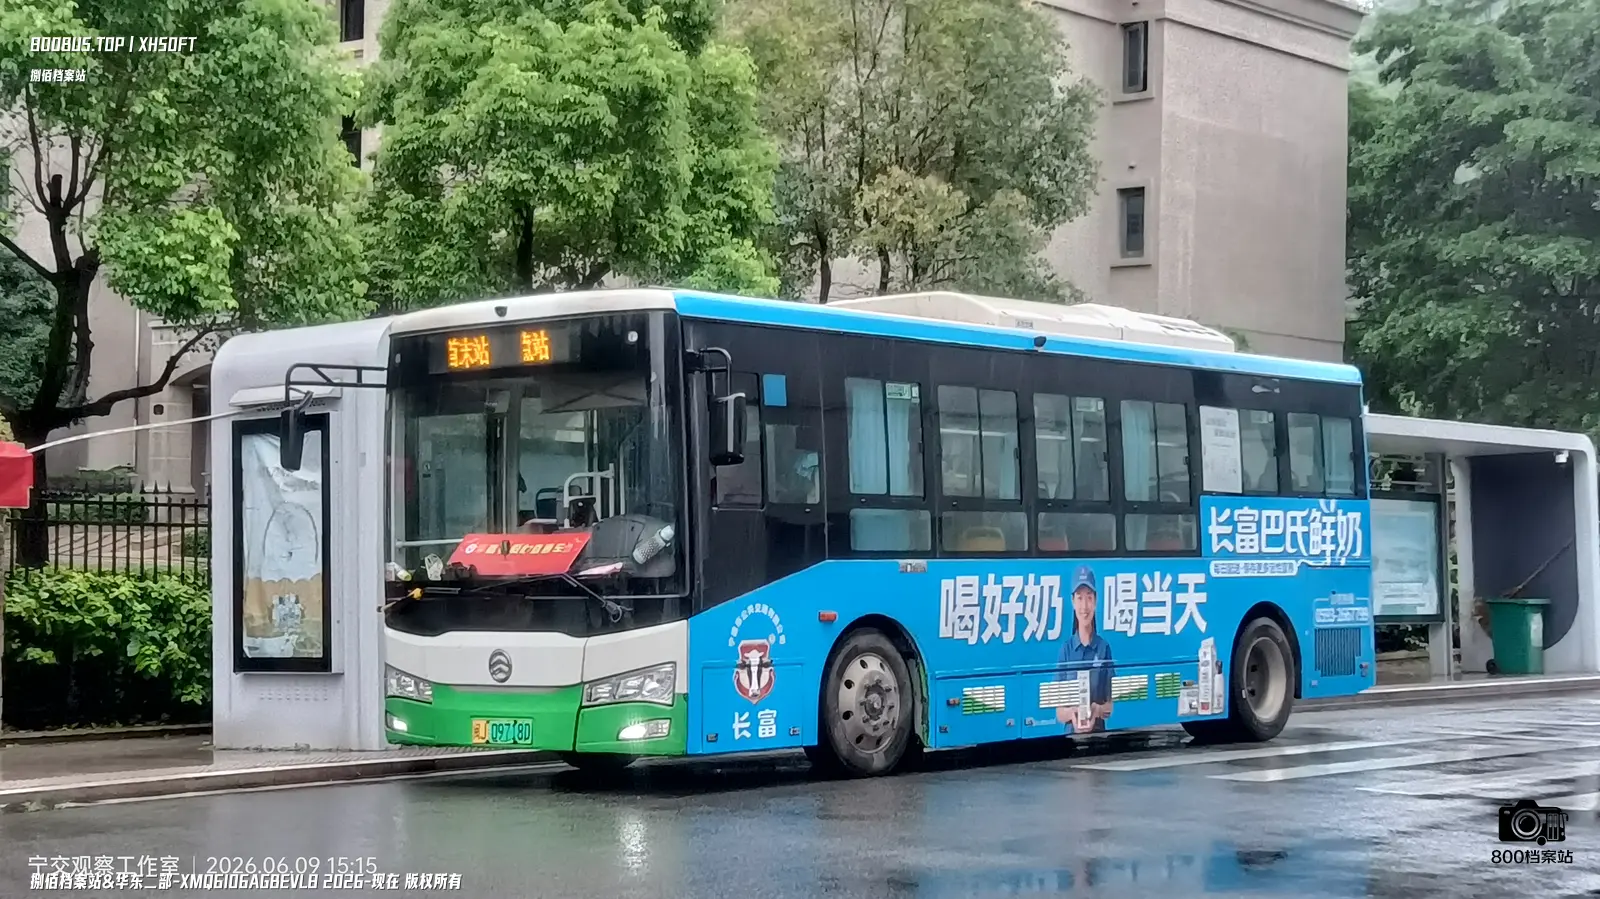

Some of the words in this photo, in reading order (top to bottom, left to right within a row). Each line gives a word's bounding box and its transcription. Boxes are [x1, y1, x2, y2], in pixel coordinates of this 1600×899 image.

[1208, 499, 1362, 565] 长富巴氏鲜奶
[938, 572, 1064, 646] 喝好奶
[1102, 570, 1209, 638] 喝当天
[732, 708, 778, 741] 长富
